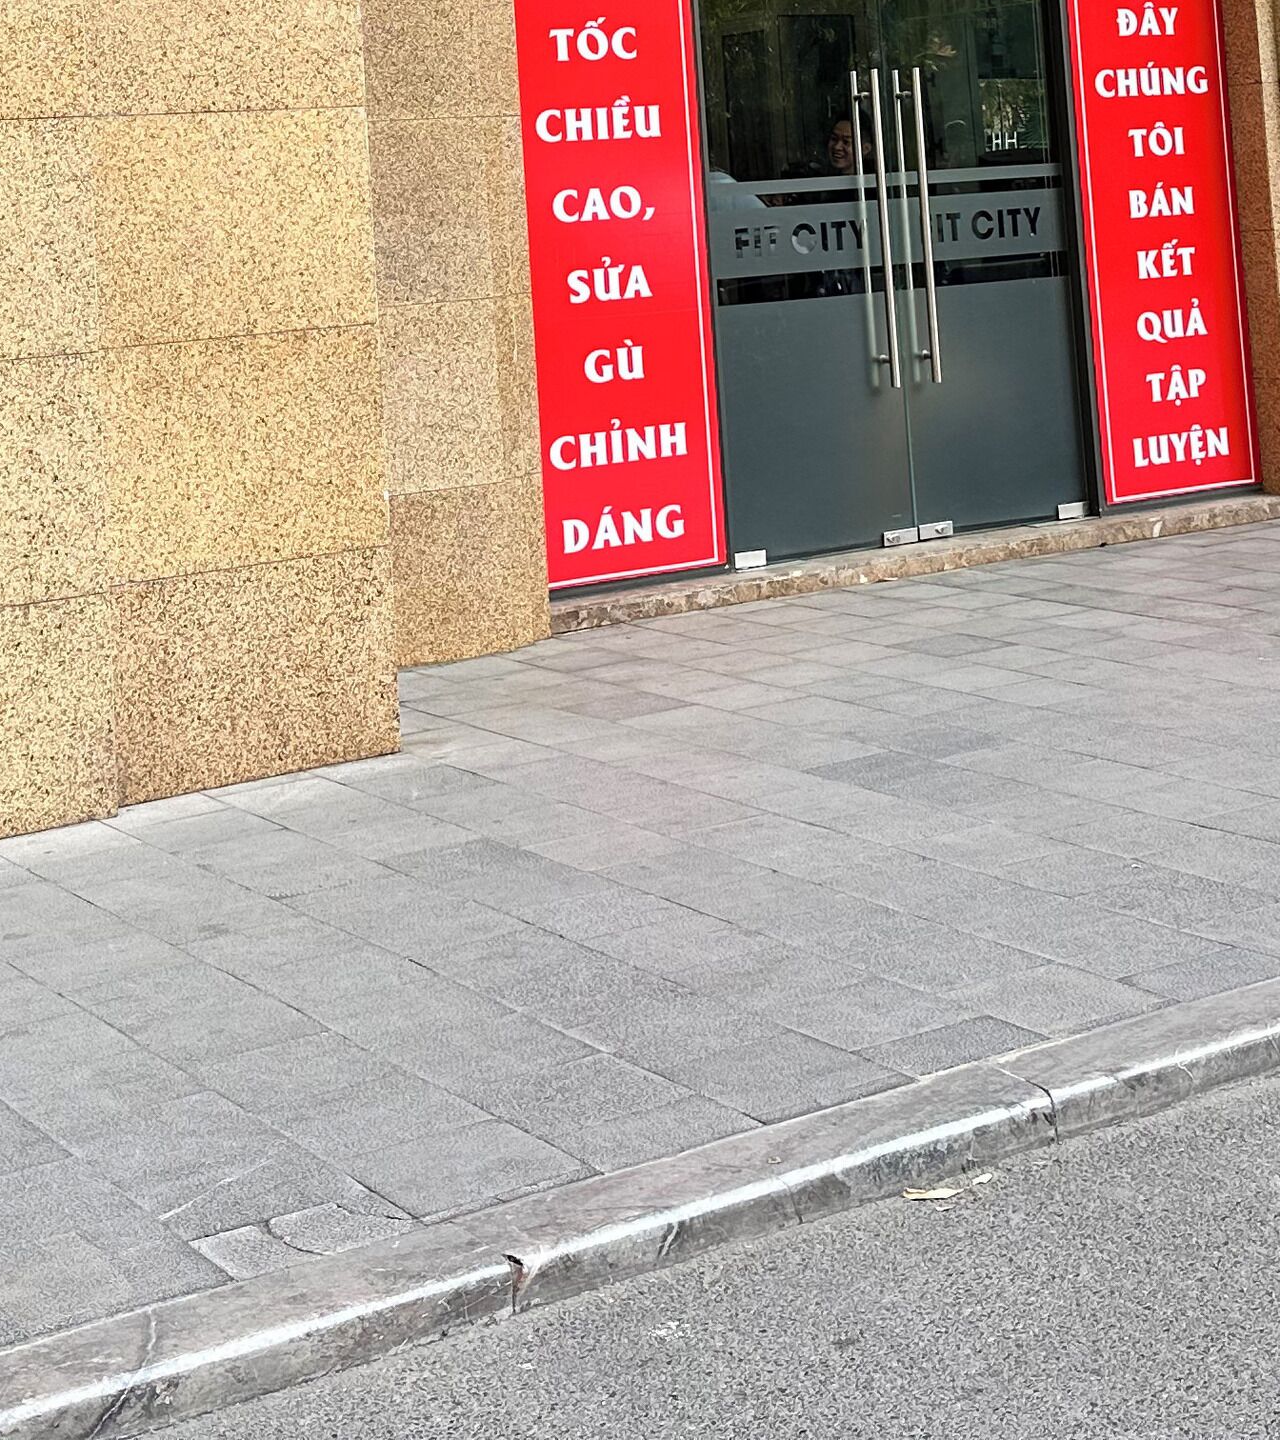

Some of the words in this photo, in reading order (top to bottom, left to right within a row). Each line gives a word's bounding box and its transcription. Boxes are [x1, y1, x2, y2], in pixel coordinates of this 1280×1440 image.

[549, 17, 637, 61] TỐC
[1116, 1, 1179, 37] ĐÂY
[1094, 62, 1209, 98] CHÚNG
[535, 95, 661, 142] CHIỀU
[1128, 121, 1185, 157] TÔI
[552, 186, 655, 222] CAO,
[1128, 181, 1195, 219] BÁN
[971, 207, 1041, 240] CITY
[567, 256, 654, 304] SỬA
[1136, 239, 1196, 280] KẾT
[1136, 298, 1208, 343] QUẢ
[584, 339, 645, 383] GÙ
[1145, 364, 1206, 407] TẬP
[549, 418, 688, 471] CHỈNH
[1132, 423, 1230, 468] LUYỆN
[562, 504, 685, 554] DÁNG
